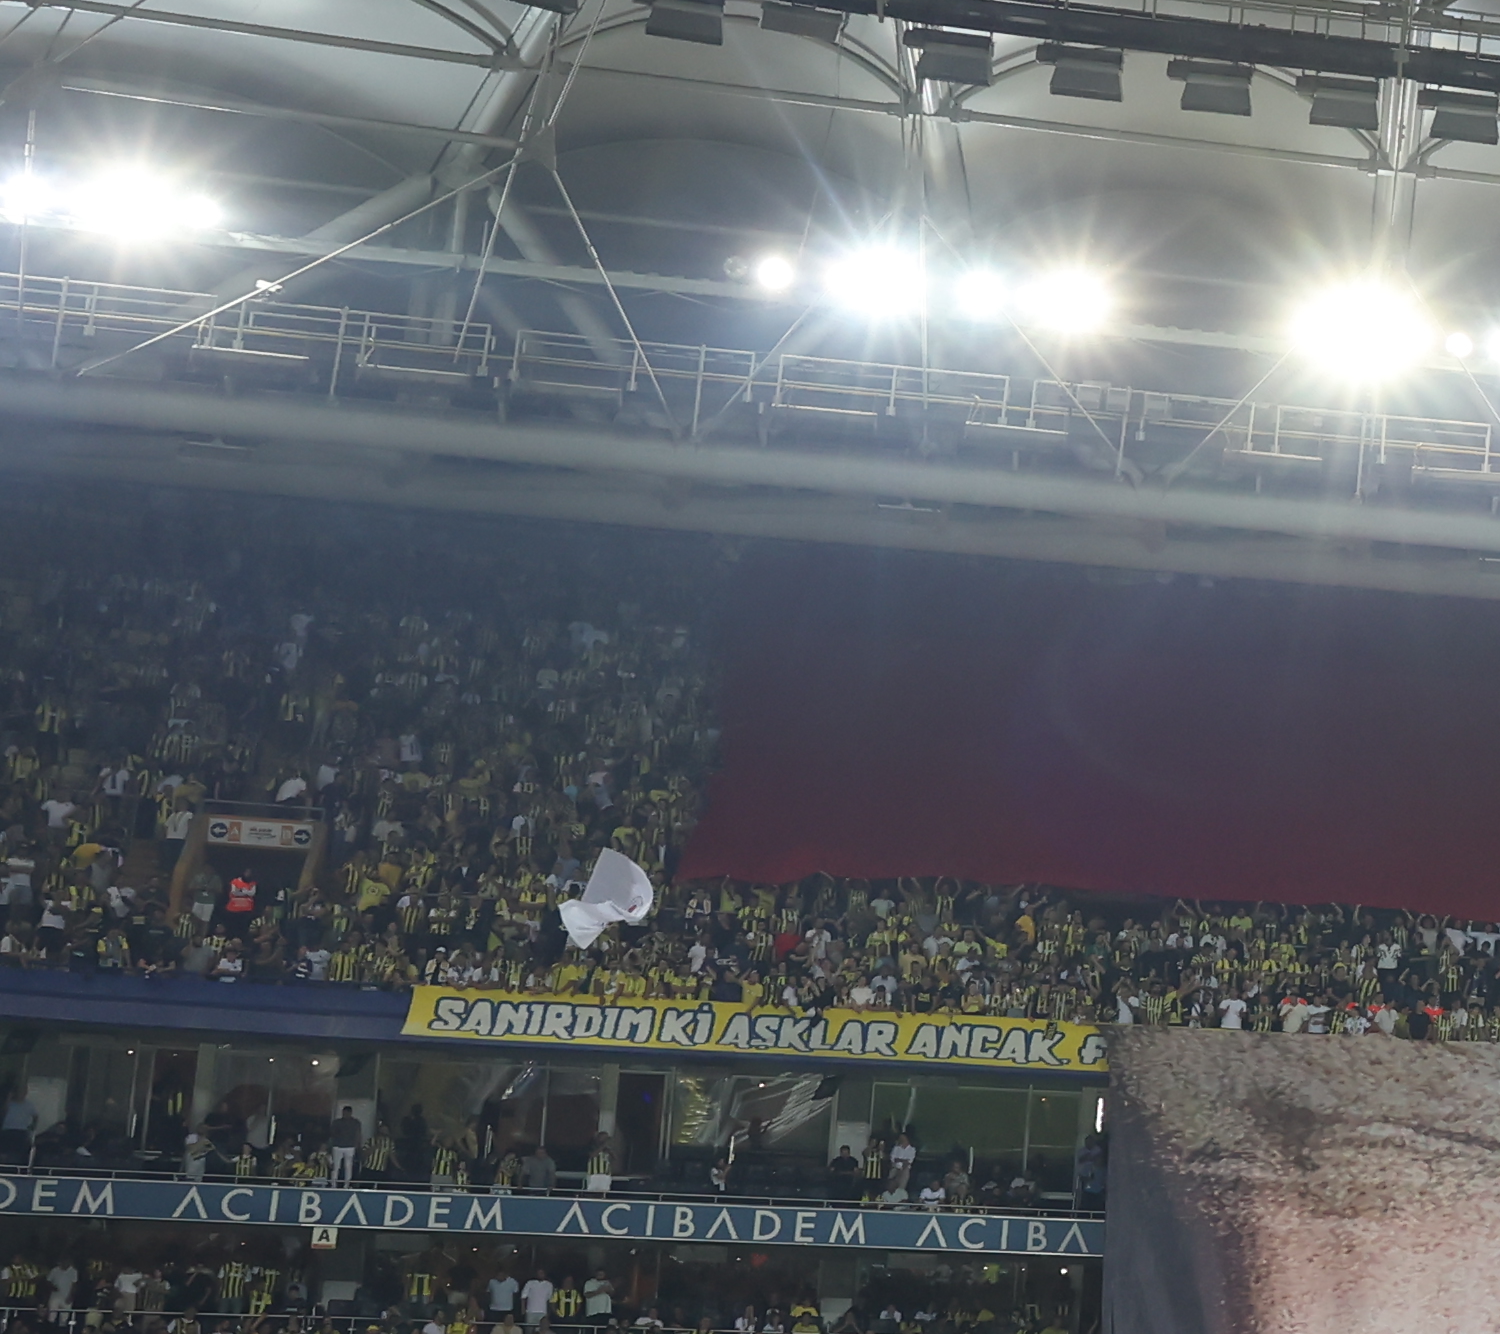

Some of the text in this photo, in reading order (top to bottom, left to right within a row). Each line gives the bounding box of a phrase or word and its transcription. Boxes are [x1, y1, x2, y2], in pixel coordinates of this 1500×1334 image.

[429, 997, 656, 1044] SANIRDIM
[657, 1001, 716, 1046] Kİ
[172, 1185, 503, 1230] ACIBADEM
[557, 1200, 866, 1245] ACIBADEM
[317, 1228, 330, 1243] A
